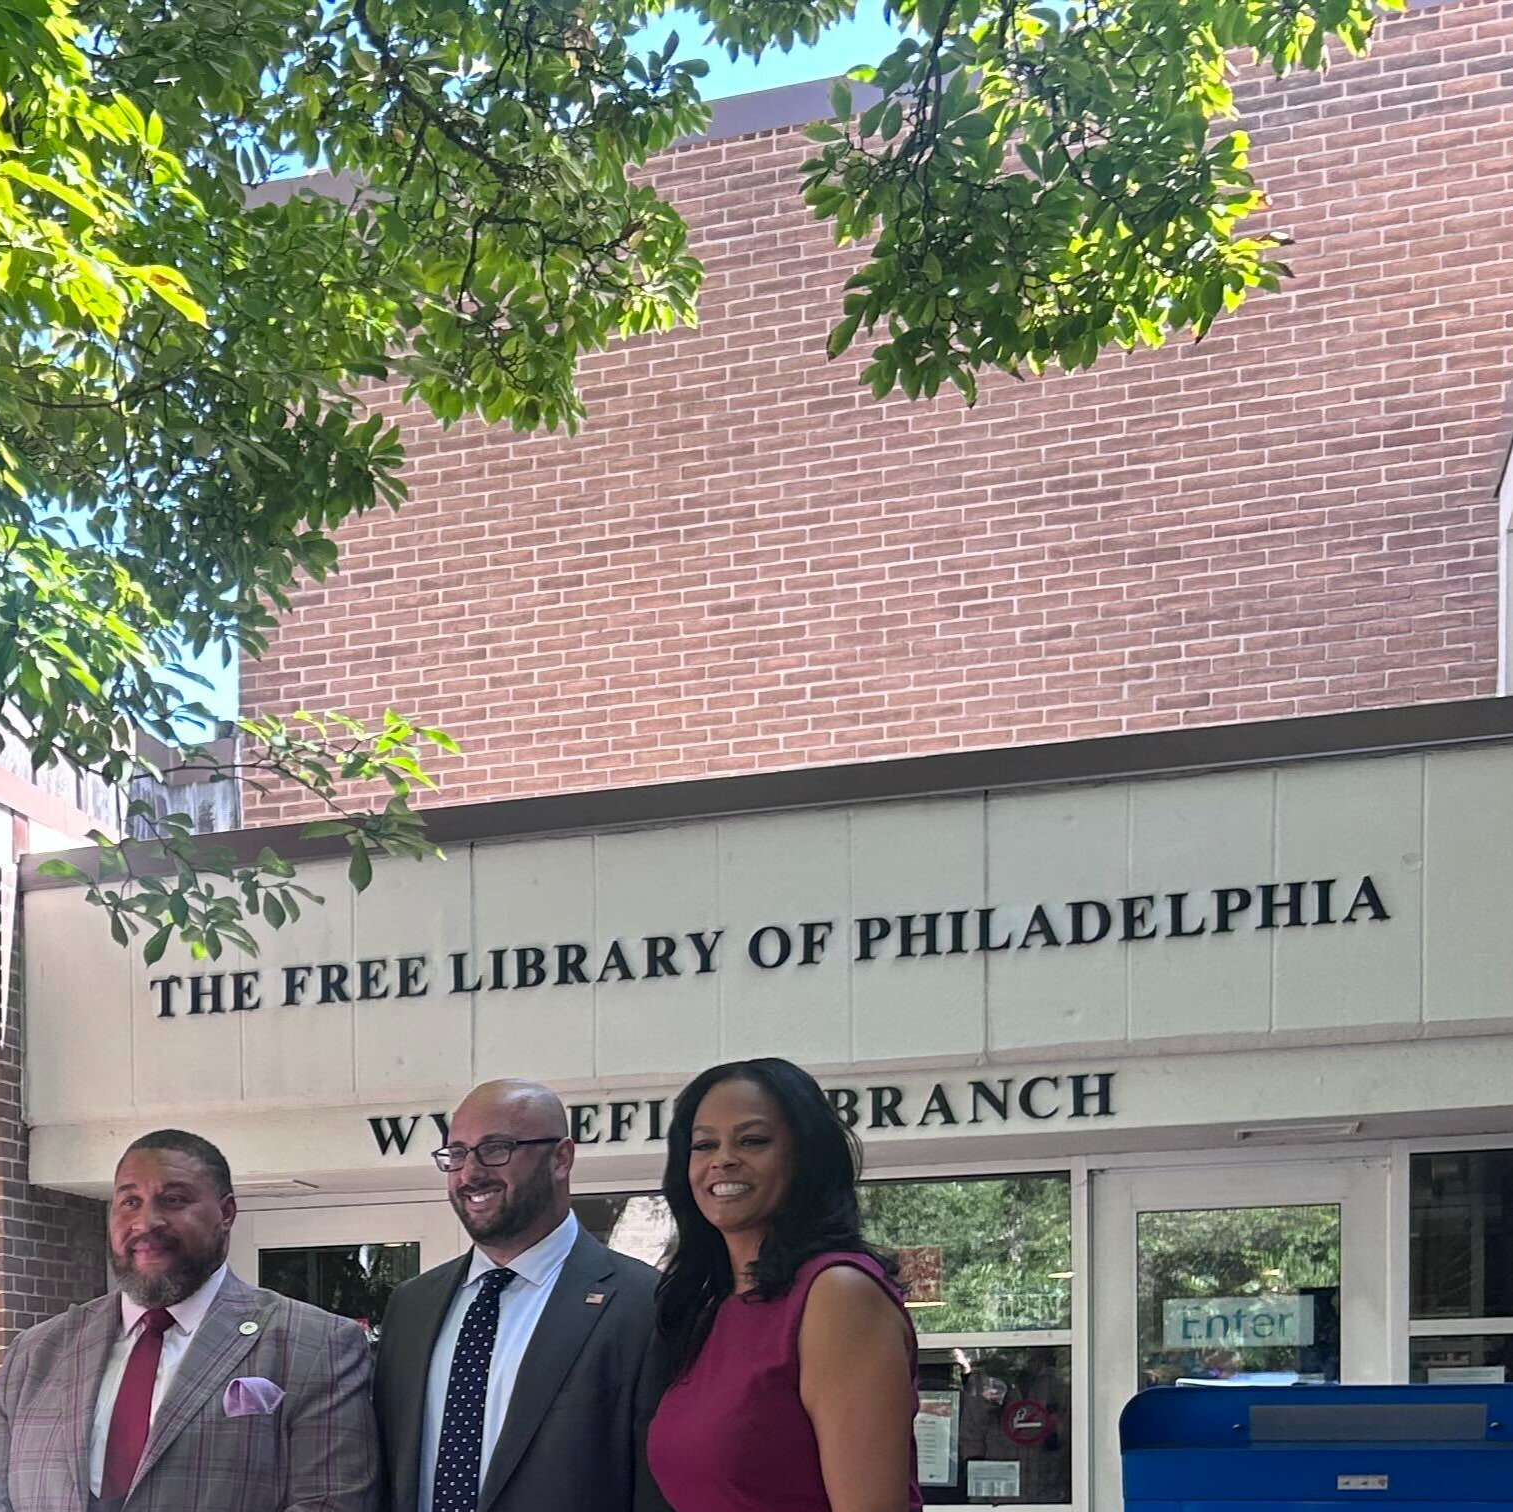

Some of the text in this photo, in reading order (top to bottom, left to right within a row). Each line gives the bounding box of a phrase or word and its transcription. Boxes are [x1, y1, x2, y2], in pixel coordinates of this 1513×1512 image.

[149, 875, 1391, 1018] THE FREE LIBRARY OF PHILADELPHIA
[823, 1071, 1117, 1130] BRANCH
[1181, 1306, 1294, 1340] Enter
